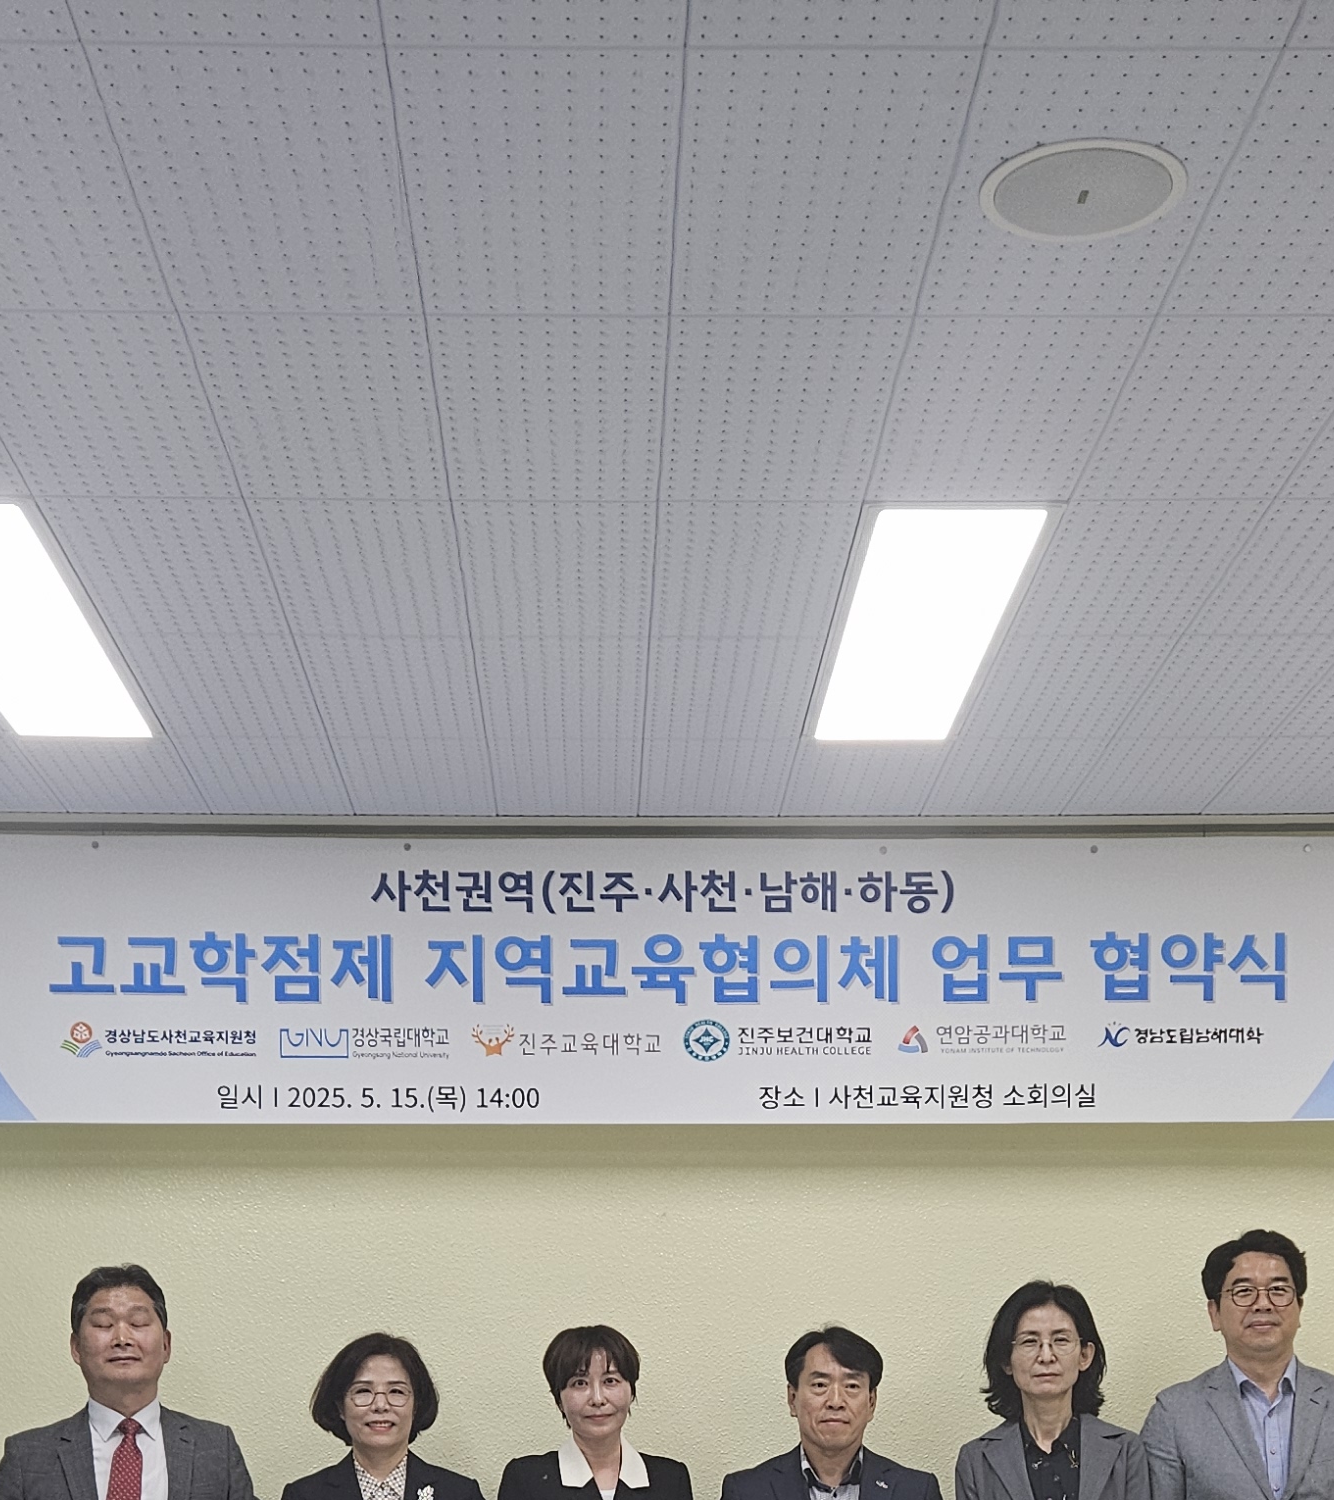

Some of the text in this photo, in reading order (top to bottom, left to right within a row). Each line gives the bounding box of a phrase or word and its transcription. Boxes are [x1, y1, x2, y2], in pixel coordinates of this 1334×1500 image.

[371, 869, 955, 915] 사천권역(진주·사천·남해·하동)
[48, 932, 1288, 1005] 고교학점제 지역교육협의체 업무 협약식
[104, 1028, 257, 1045] 경상남도사천교육지원청
[280, 1027, 350, 1049] GNU
[351, 1025, 450, 1048] 경상국립대학교
[518, 1032, 662, 1057] 진주교육대학교
[737, 1025, 873, 1044] 진주보건대학교
[935, 1023, 1067, 1045] 연암공과대학교
[1133, 1026, 1265, 1045] 경남도립남해대학
[352, 1050, 450, 1060] Gyeongsang National University
[737, 1046, 872, 1056] JINJU HEALTH COLLEGE
[217, 1084, 262, 1110] 일시
[287, 1086, 353, 1109] 2025.
[360, 1087, 382, 1109] 5.
[390, 1085, 466, 1113] 15.(목)
[476, 1087, 540, 1109] 14:00
[758, 1085, 806, 1110] 장소
[828, 1084, 993, 1110] 사천교육지원청
[1002, 1083, 1097, 1109] 소회의실
